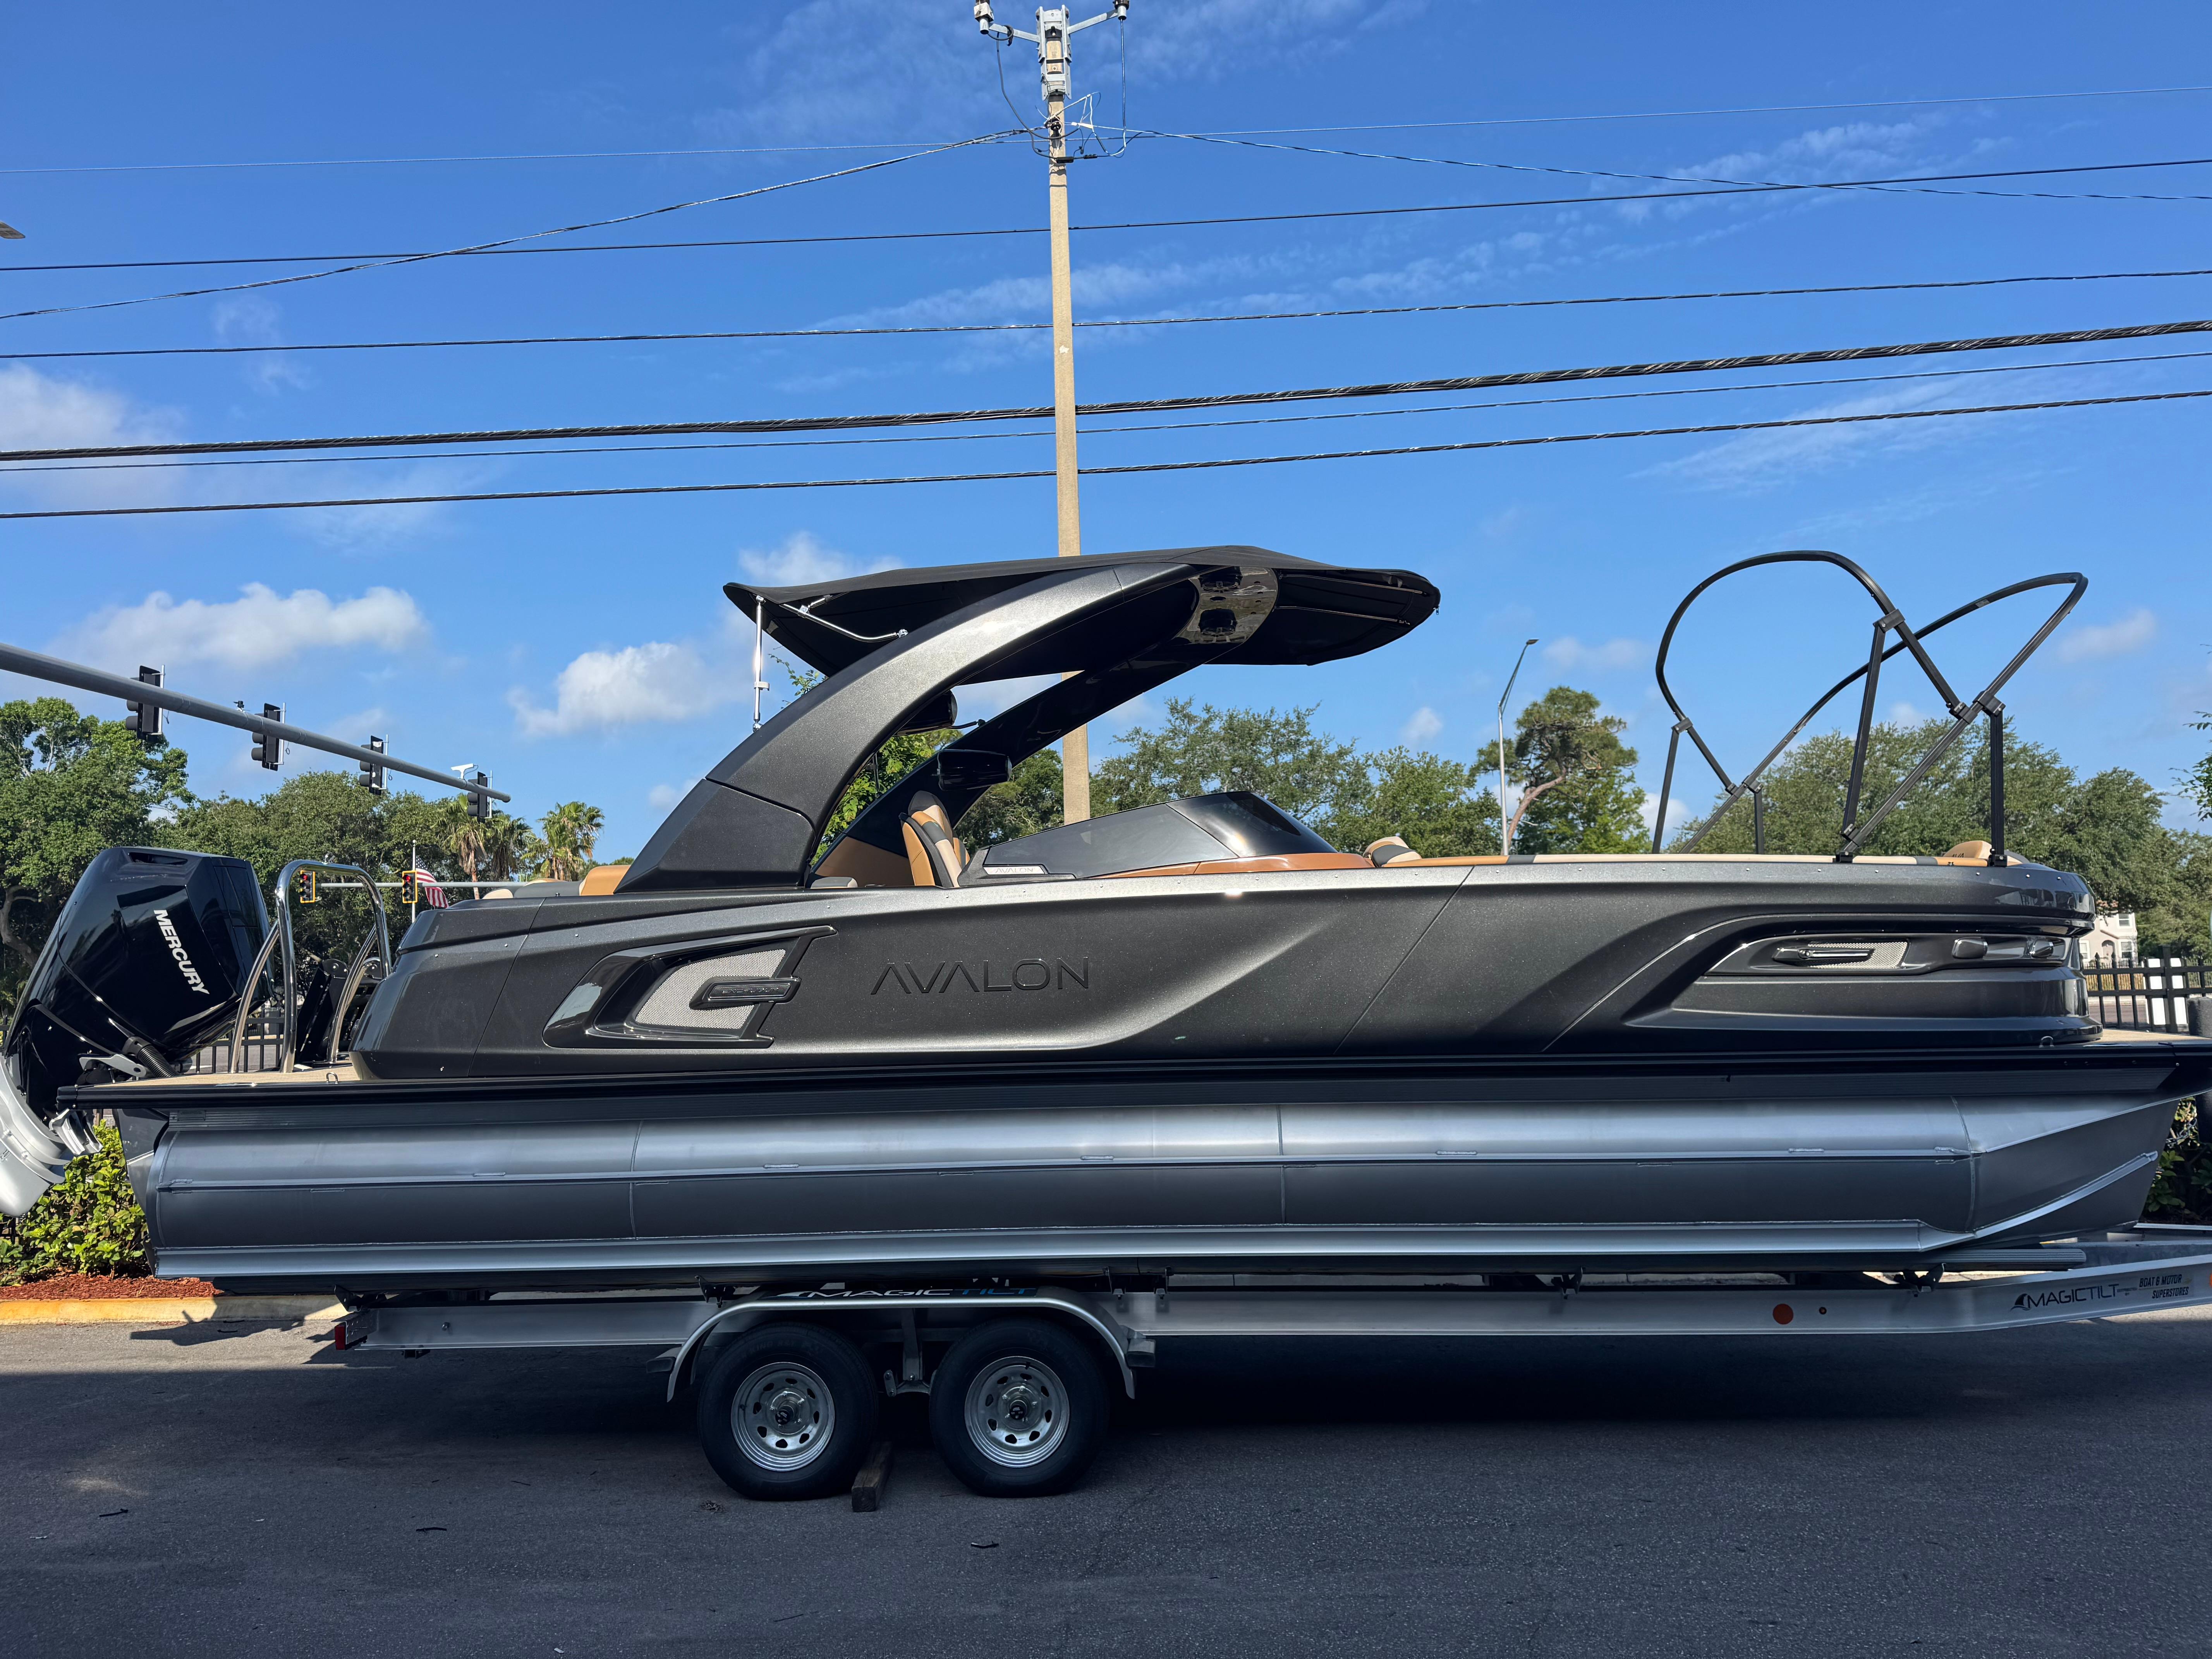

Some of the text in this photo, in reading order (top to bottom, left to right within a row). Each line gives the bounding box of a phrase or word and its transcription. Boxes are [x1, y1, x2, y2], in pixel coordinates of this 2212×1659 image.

[153, 910, 210, 994] MERCURY
[870, 957, 1089, 994] AVALON
[2139, 1274, 2182, 1288] BOAT & MOTOR
[807, 1288, 1037, 1297] MAGICTILT
[2027, 1283, 2119, 1309] MAGICTILT
[2152, 1286, 2189, 1299] SUPERSTORES
